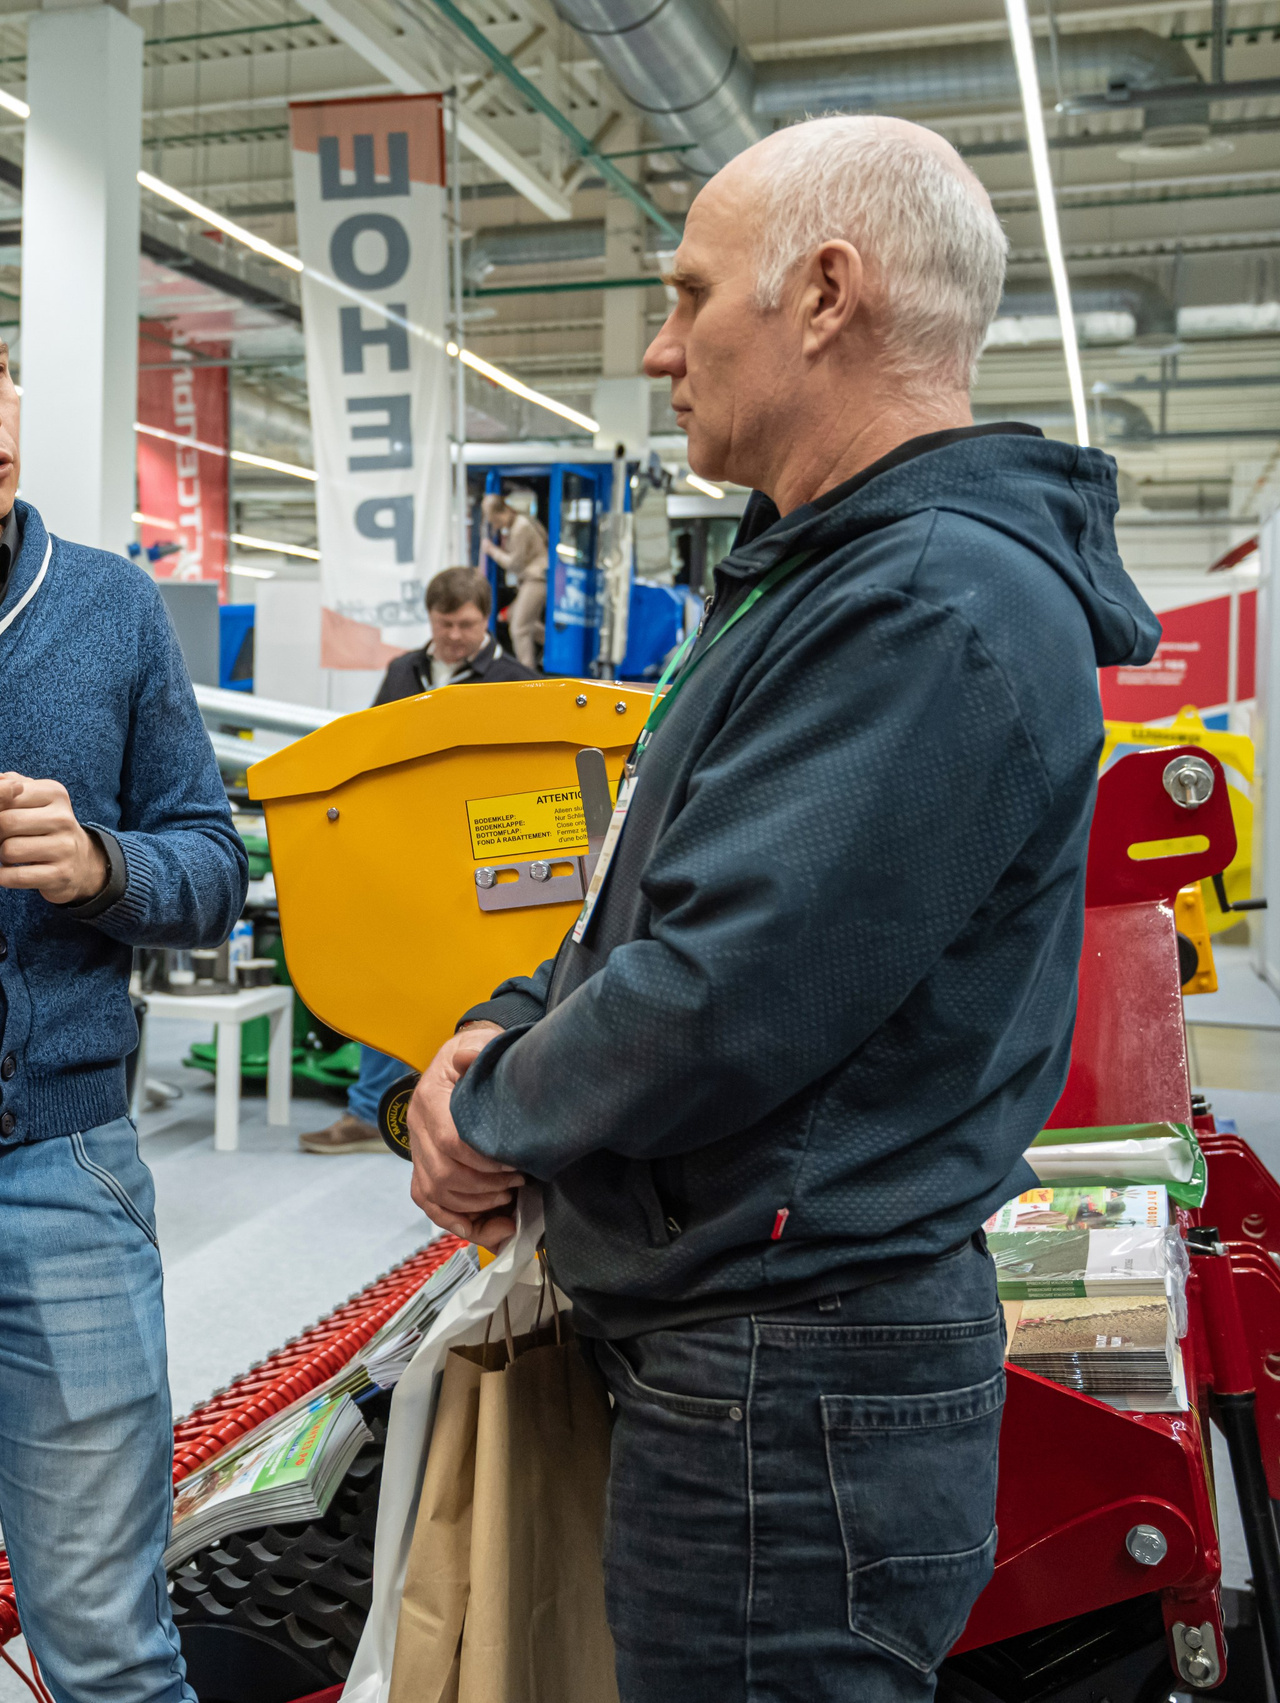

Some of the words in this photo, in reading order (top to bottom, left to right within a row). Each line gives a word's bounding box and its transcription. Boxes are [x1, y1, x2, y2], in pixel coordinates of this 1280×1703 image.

[474, 814, 517, 825] BODEMKLEP:
[475, 820, 526, 832] BODENKLAPPE:
[476, 828, 522, 839] BOTTOMFLAP:
[477, 838, 496, 846] FOND
[502, 831, 552, 843] RABATTEMENT:
